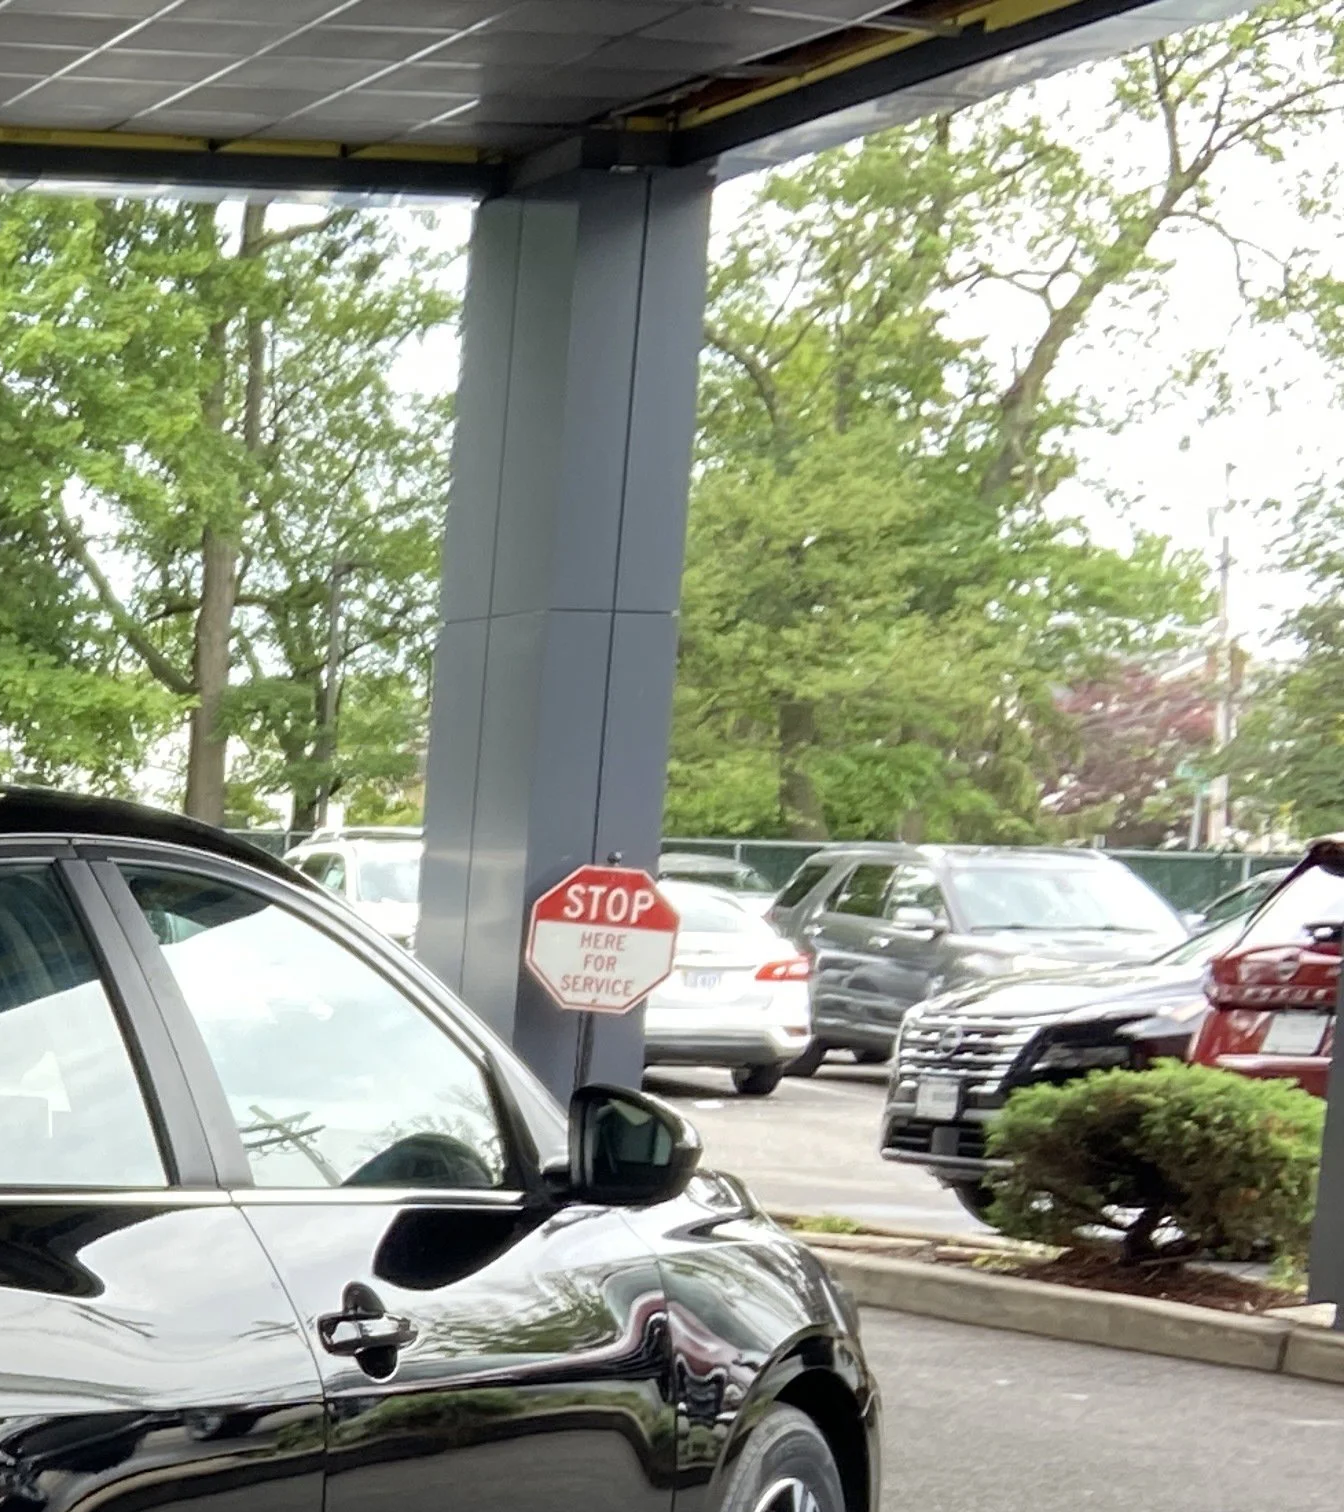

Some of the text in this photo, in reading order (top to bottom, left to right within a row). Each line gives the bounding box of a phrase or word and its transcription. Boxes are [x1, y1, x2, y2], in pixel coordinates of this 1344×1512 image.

[563, 883, 655, 925] STOP
[579, 931, 627, 951] HERE
[583, 954, 617, 973] FOR
[560, 974, 635, 997] SERVICE
